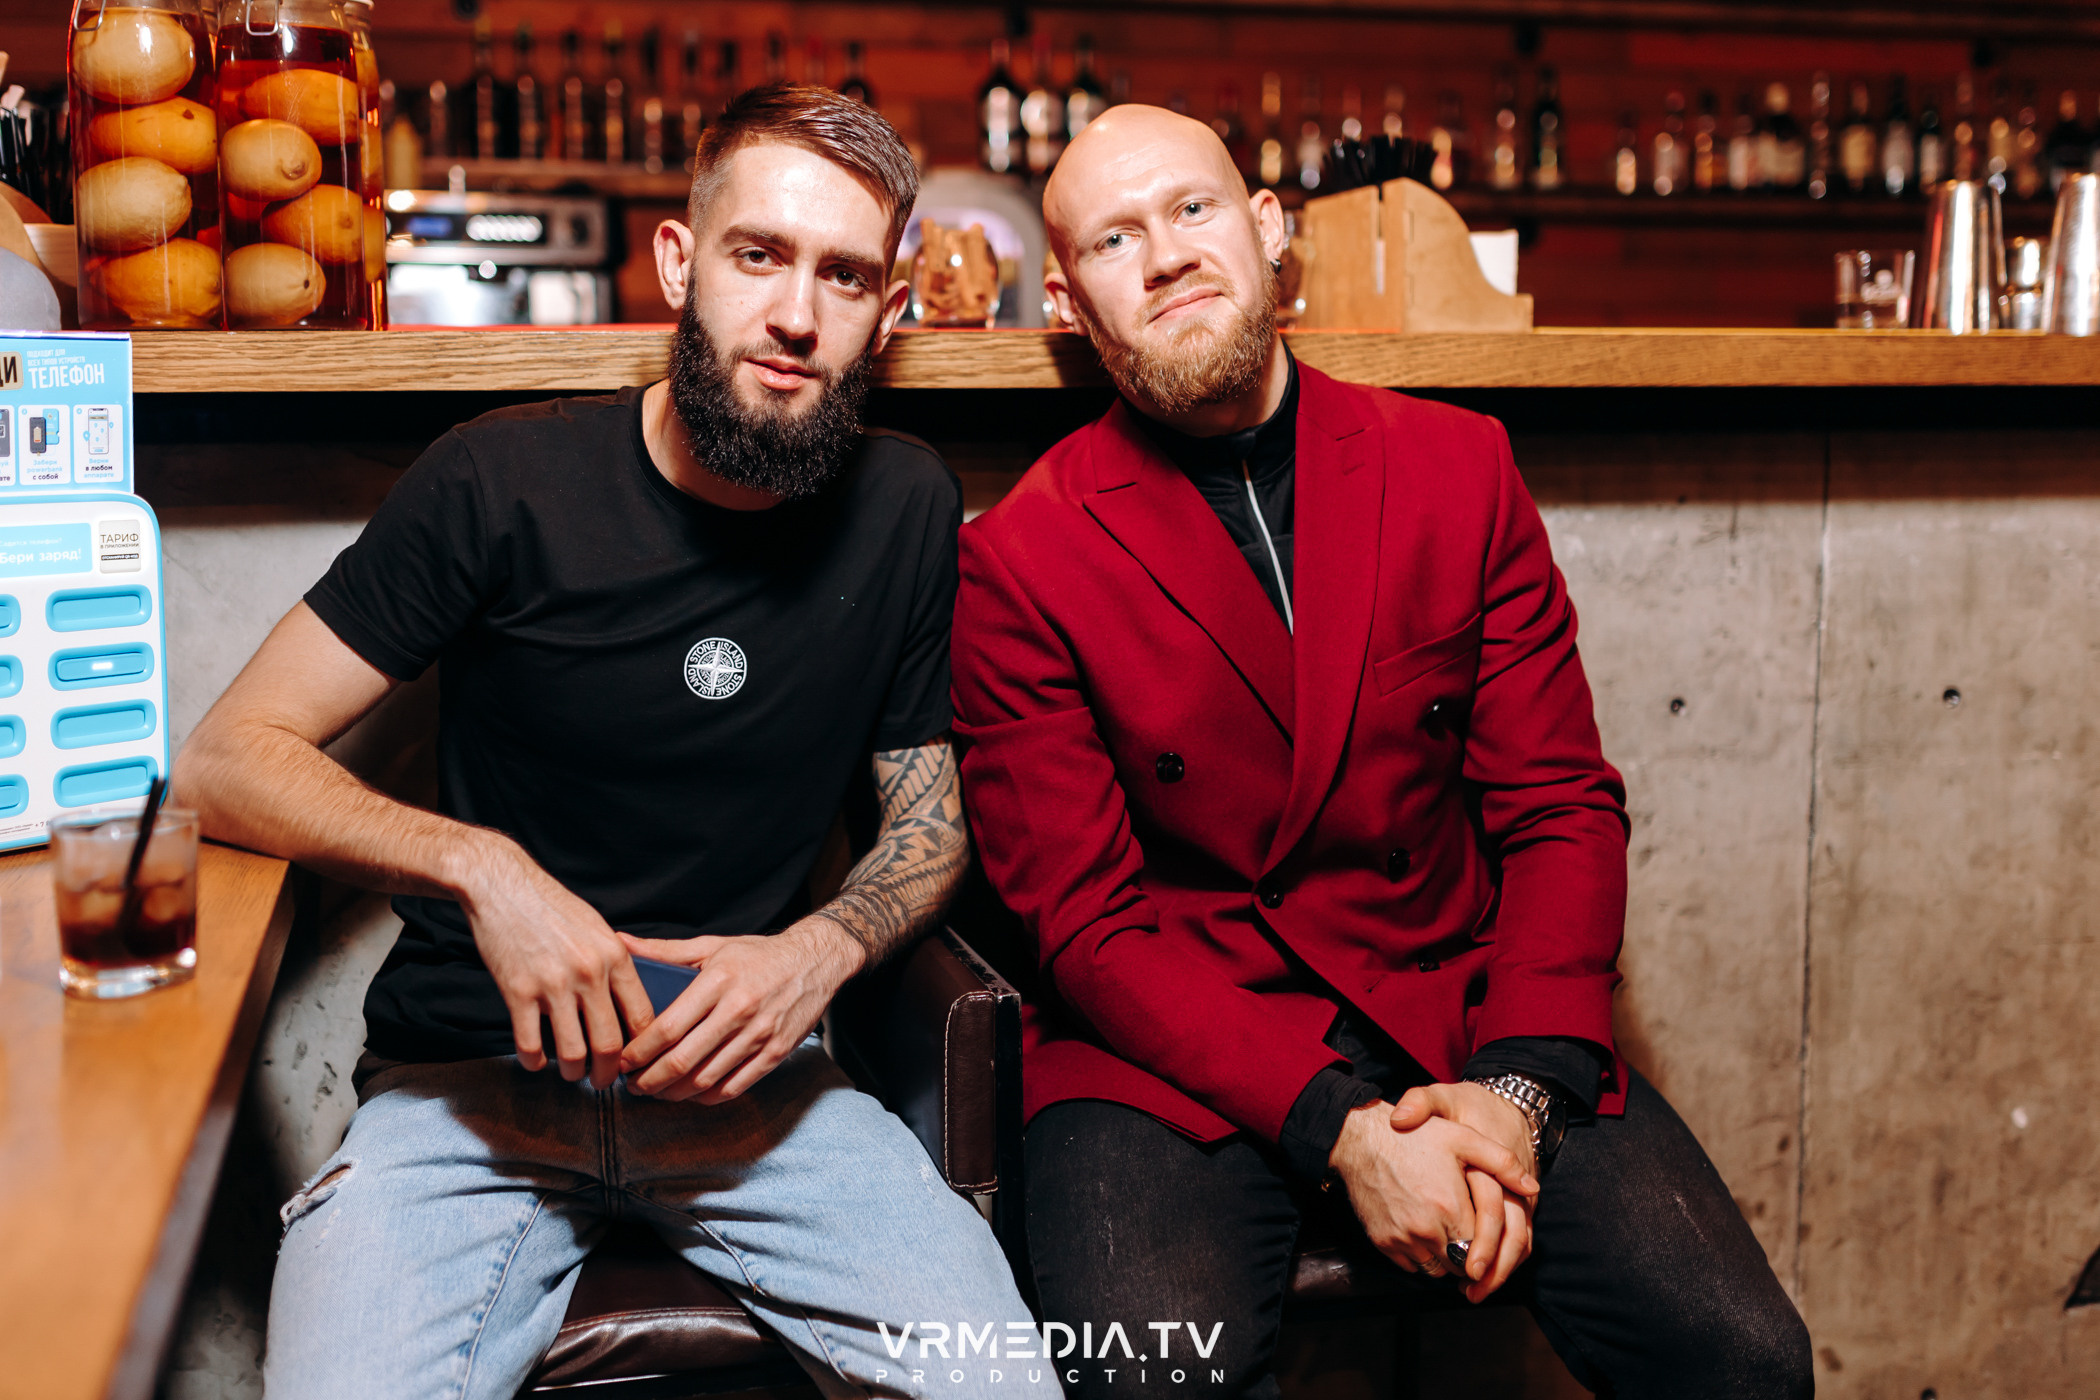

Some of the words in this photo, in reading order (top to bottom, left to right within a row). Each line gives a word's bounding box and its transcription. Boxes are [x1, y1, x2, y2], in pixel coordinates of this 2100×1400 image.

[0, 356, 17, 387] И
[28, 363, 104, 389] ТЕЛЕФОН
[100, 533, 139, 543] ТАРИФ
[0, 551, 34, 565] Бери
[39, 547, 82, 563] заряд!
[690, 641, 716, 663] STONE
[719, 641, 744, 669] ISLAND
[688, 668, 711, 696] ISLAND
[715, 673, 743, 696] STONE
